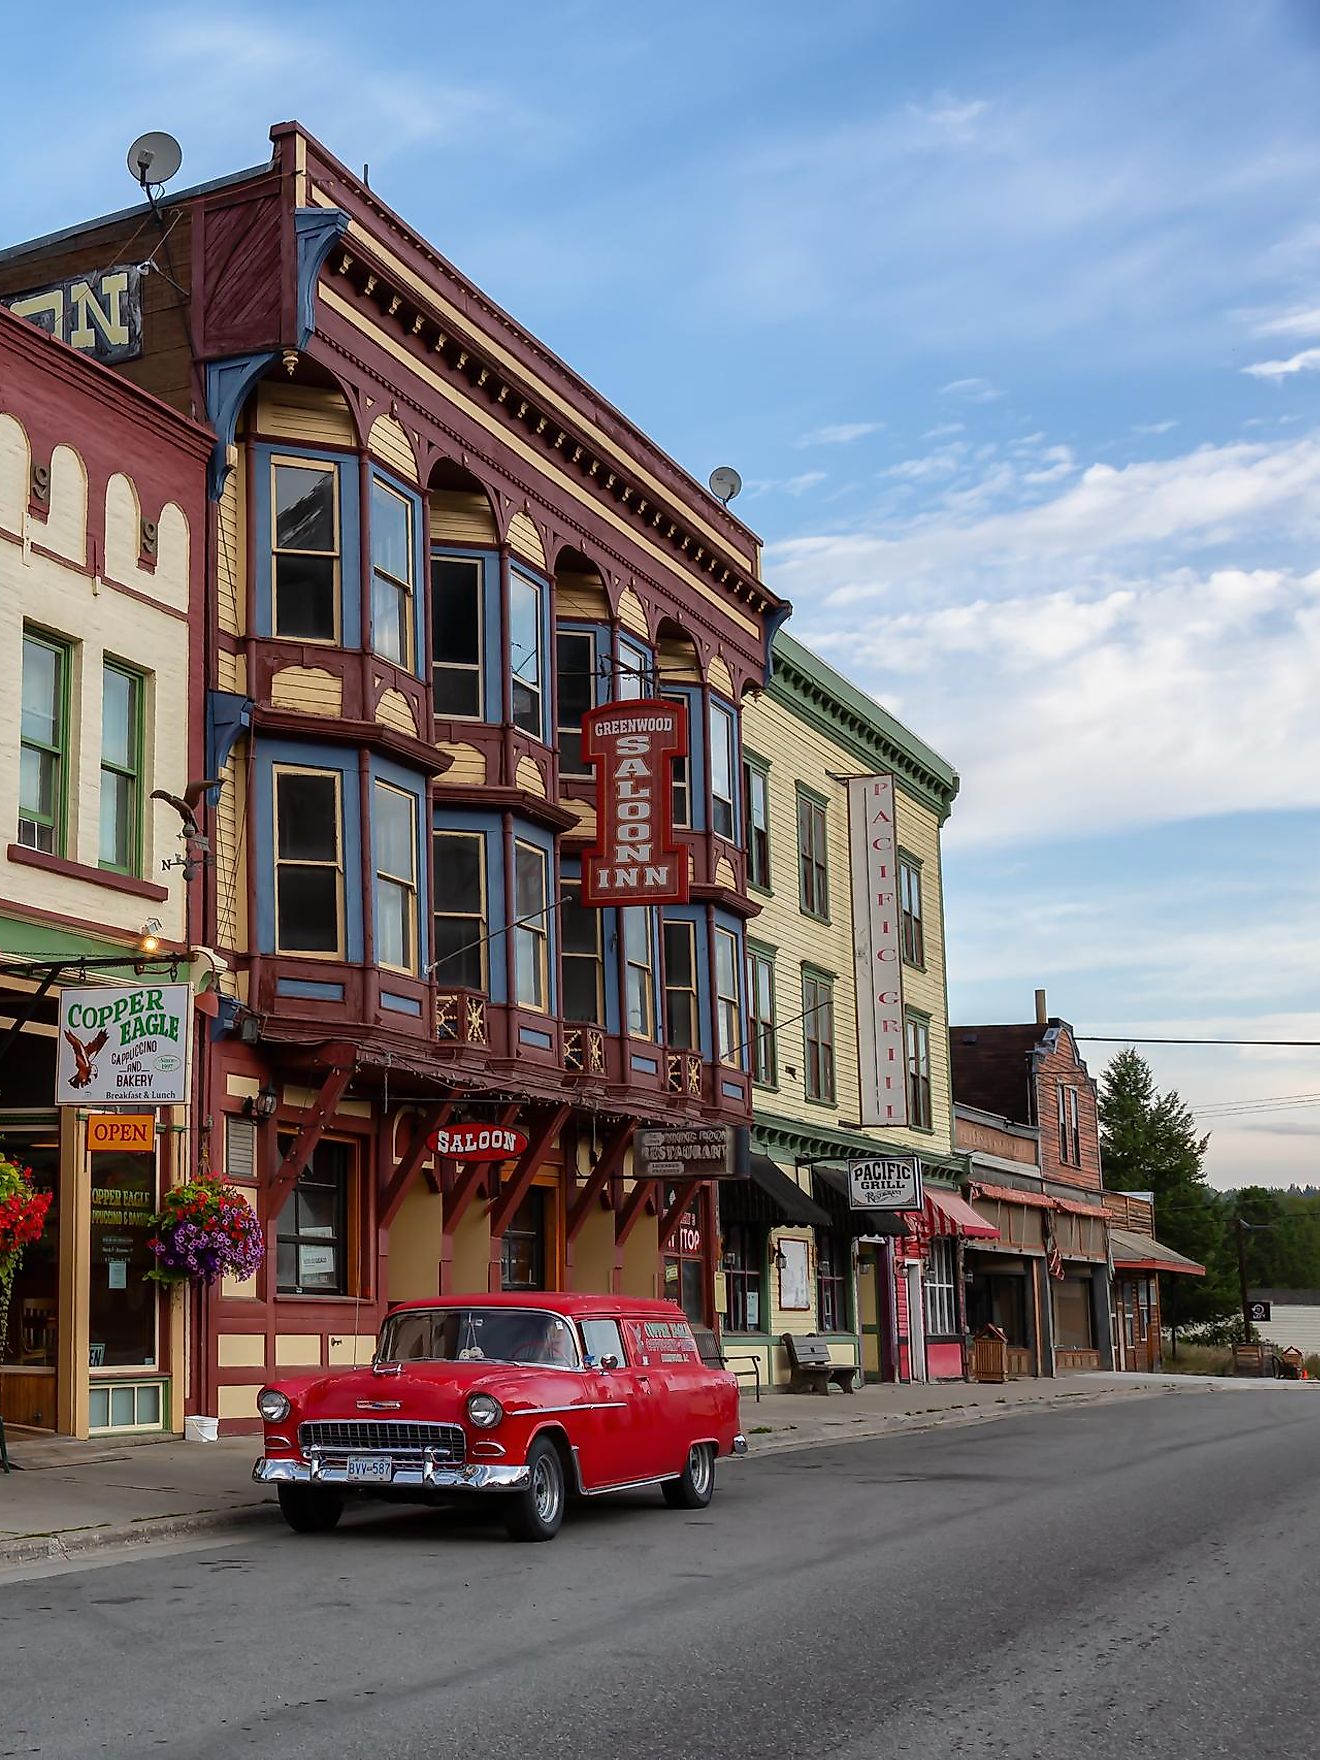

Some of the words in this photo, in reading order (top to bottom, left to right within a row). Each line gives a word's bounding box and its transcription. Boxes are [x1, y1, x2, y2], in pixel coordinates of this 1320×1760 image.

[595, 718, 672, 737] GREENWOOD
[614, 735, 652, 863] SALOON
[598, 866, 669, 888] INN
[872, 782, 898, 962] PACIFIC
[67, 989, 165, 1030] COPPER
[119, 1014, 180, 1047] EAGLE
[111, 1040, 158, 1066] CAPPUCCINO
[878, 991, 902, 1119] GRILL
[126, 1061, 142, 1073] AND
[116, 1074, 154, 1088] BAKERY
[106, 1091, 142, 1099] Breakfast
[144, 1091, 150, 1099] &
[152, 1090, 176, 1099] Lunch
[94, 1123, 148, 1142] OPEN
[436, 1129, 517, 1154] SALOON
[854, 1161, 911, 1181] PACIFIC
[861, 1180, 906, 1190] GRILL
[91, 1187, 122, 1206] OPPER
